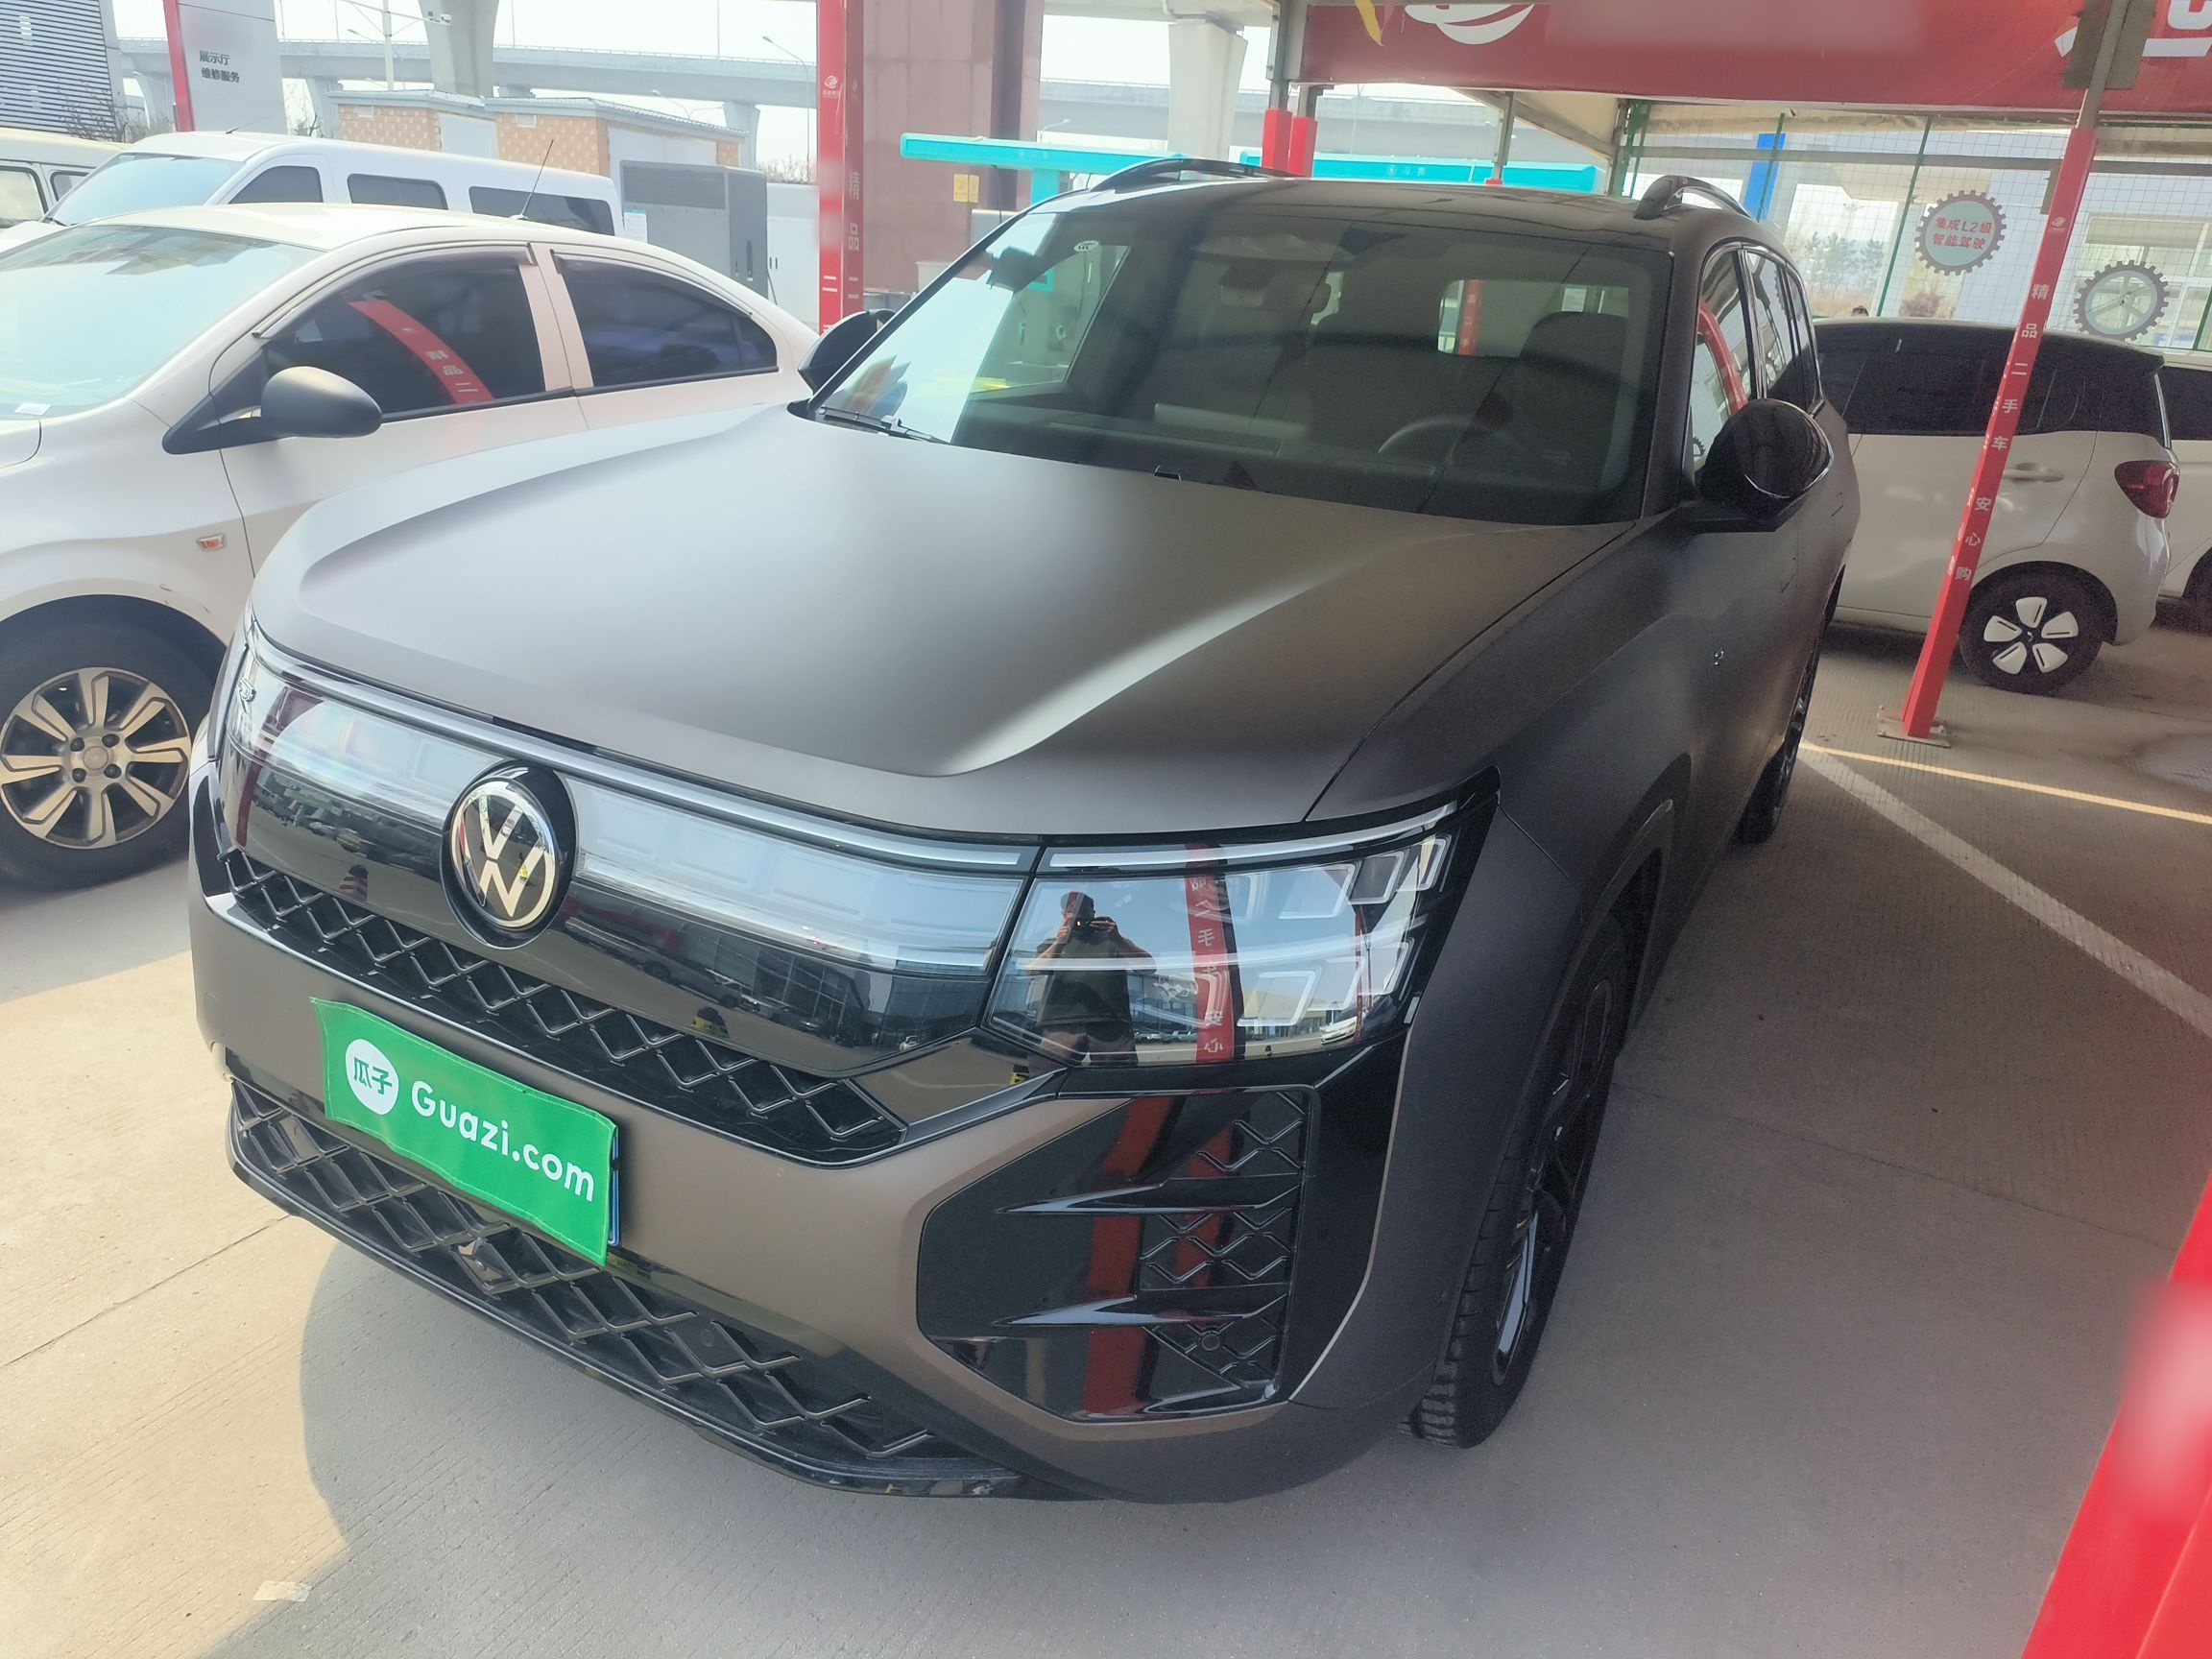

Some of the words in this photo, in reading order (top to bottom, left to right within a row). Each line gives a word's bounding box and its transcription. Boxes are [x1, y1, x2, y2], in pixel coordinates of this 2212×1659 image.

[202, 67, 240, 83] 维修服务
[1935, 217, 1992, 234] 集成L2级
[1932, 233, 1985, 250] 智能驾驶
[352, 1056, 393, 1094] 瓜子
[411, 1080, 594, 1202] Guazi.com
